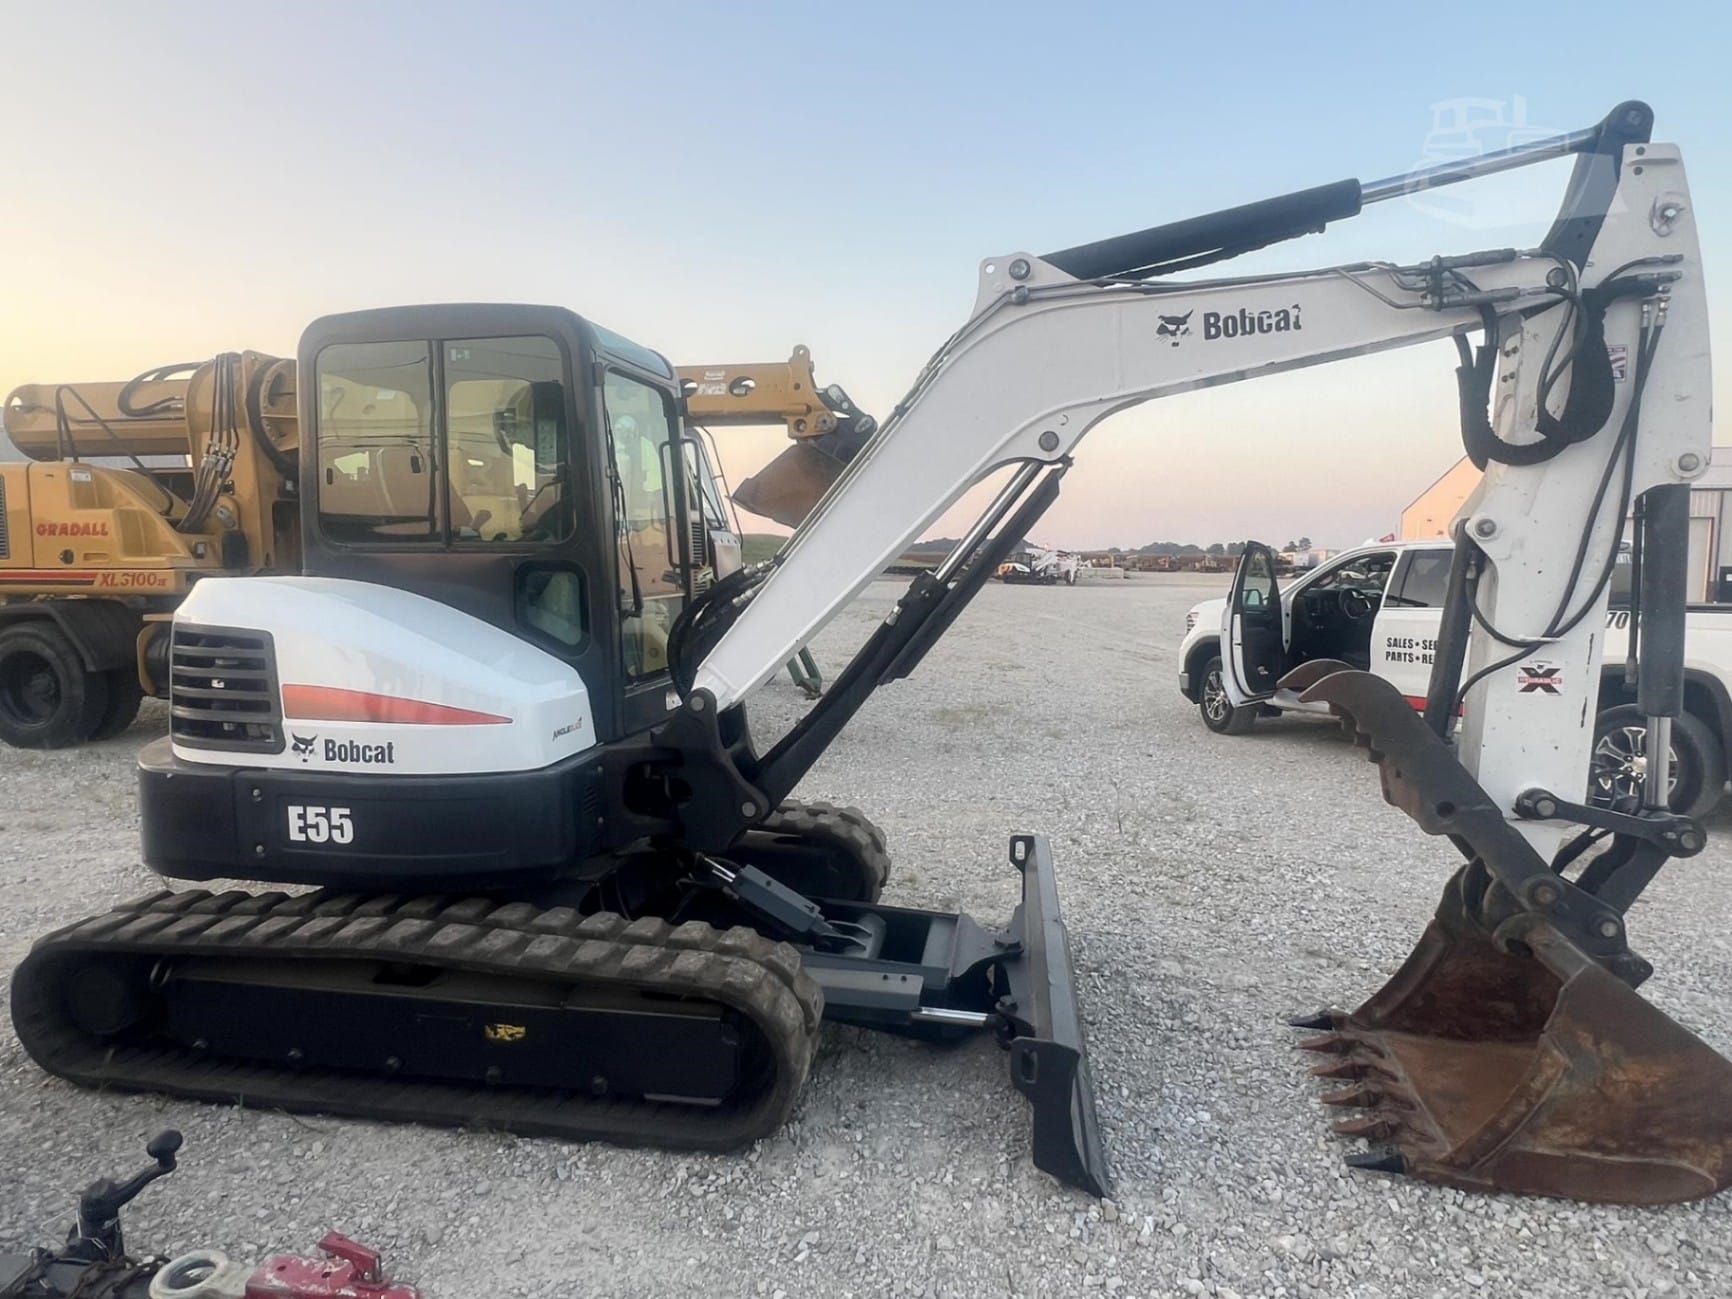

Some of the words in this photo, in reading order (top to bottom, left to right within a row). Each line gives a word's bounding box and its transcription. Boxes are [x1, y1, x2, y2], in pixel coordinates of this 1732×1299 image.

[1203, 304, 1302, 340] Bobcat
[36, 523, 109, 537] GRADALL
[1386, 637, 1414, 649] SALES
[1386, 651, 1414, 663] PARTS
[325, 738, 394, 763] Bobcat
[287, 805, 354, 844] E55
